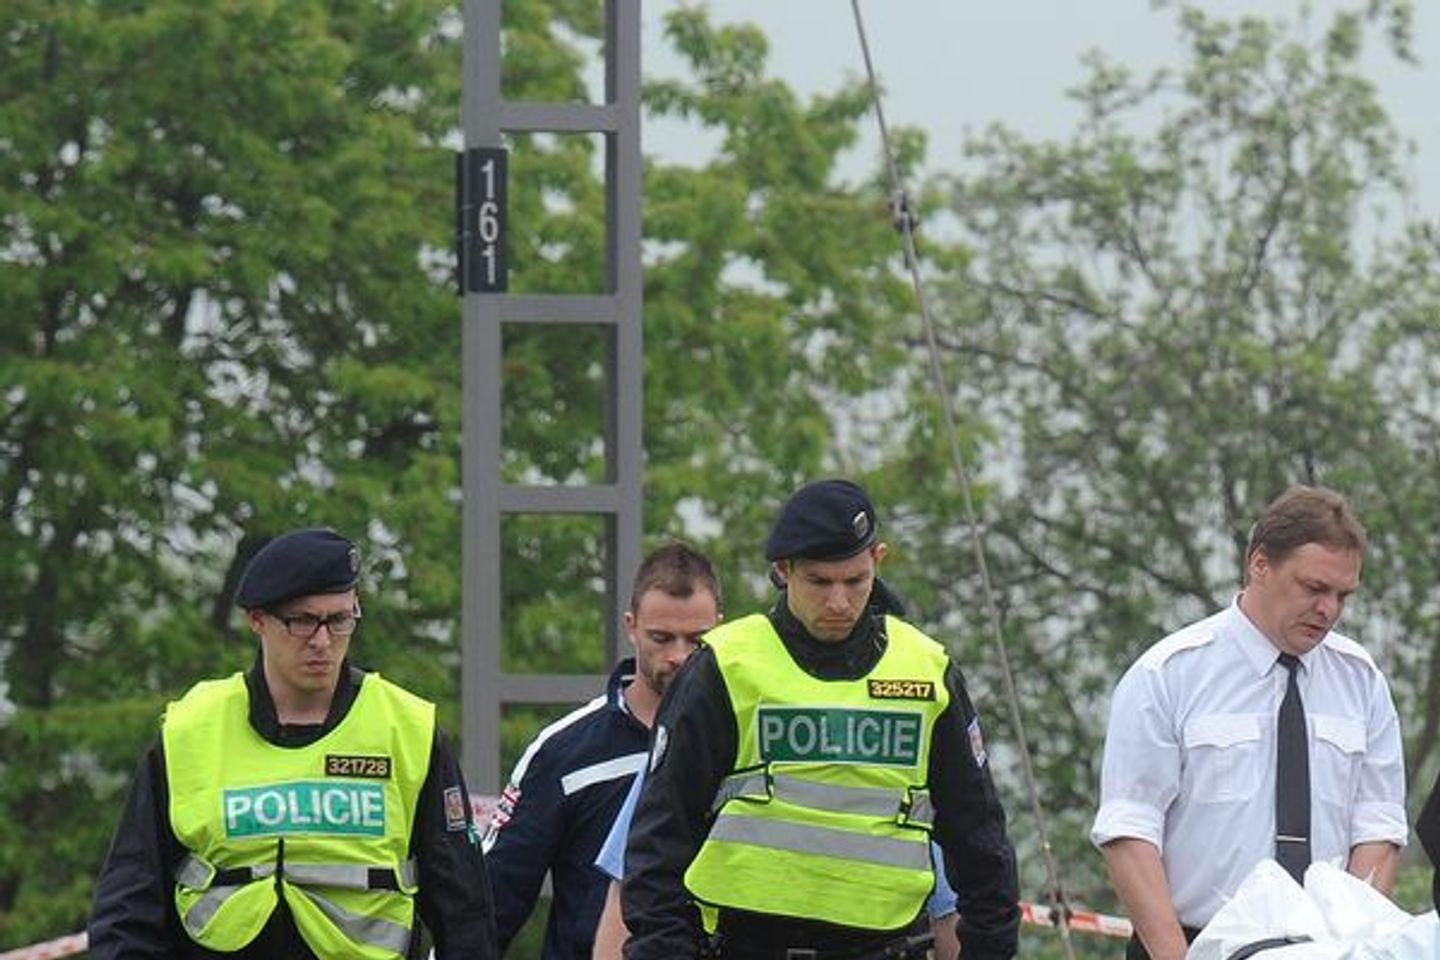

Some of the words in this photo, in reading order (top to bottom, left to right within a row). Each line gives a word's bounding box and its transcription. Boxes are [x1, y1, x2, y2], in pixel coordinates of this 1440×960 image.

[479, 159, 499, 285] 161
[871, 681, 931, 698] 325217
[762, 714, 917, 757] POLICIE
[329, 758, 388, 776] 321728
[227, 789, 384, 829] POLICIE
